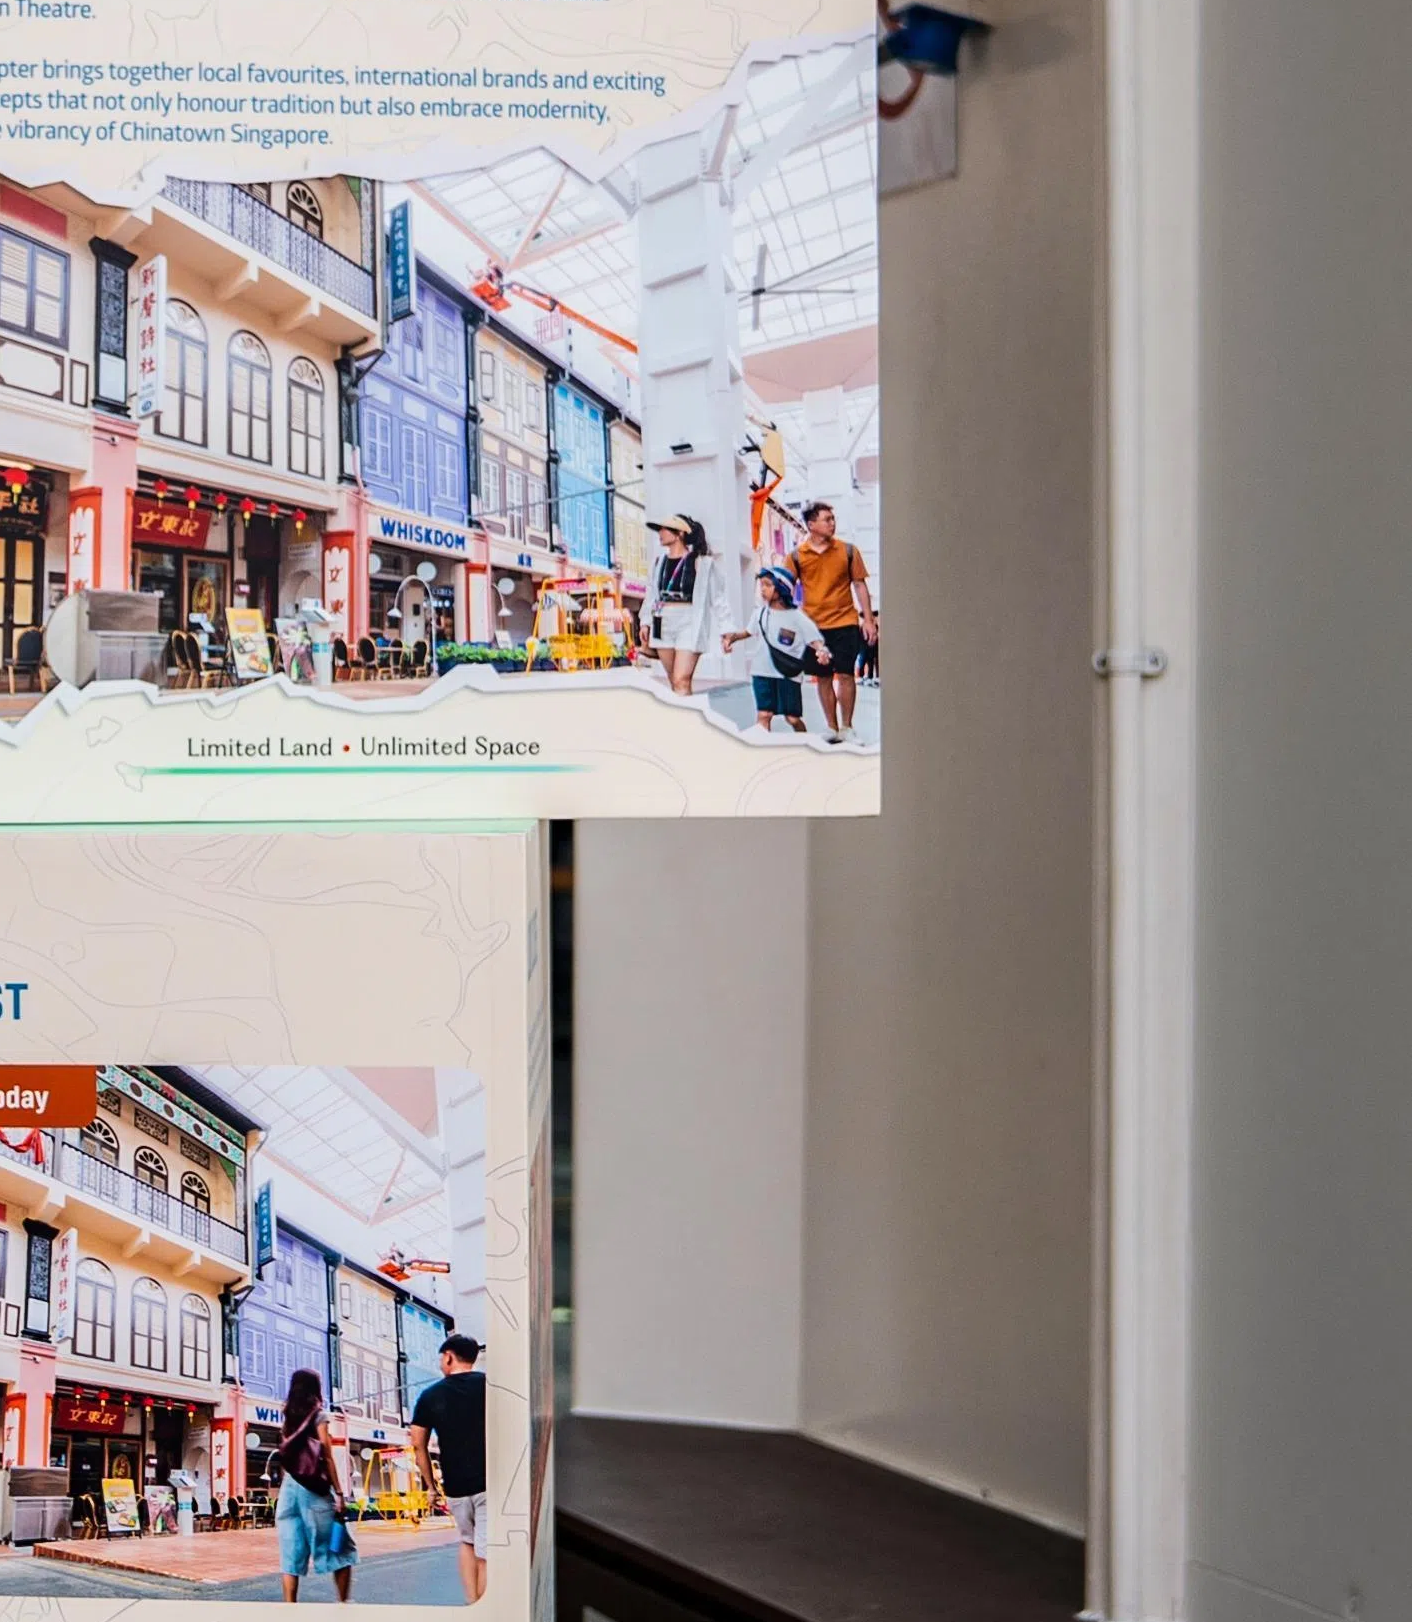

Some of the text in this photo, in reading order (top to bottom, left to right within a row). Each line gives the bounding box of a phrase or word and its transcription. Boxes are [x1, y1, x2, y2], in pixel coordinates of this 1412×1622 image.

[6, 119, 92, 146] vibrancy
[95, 120, 117, 141] of
[120, 121, 225, 143] Chinatown
[230, 123, 335, 150] Singapore.
[380, 516, 467, 551] WHISKDOM
[187, 736, 540, 761] Limited Land Unlimited Space
